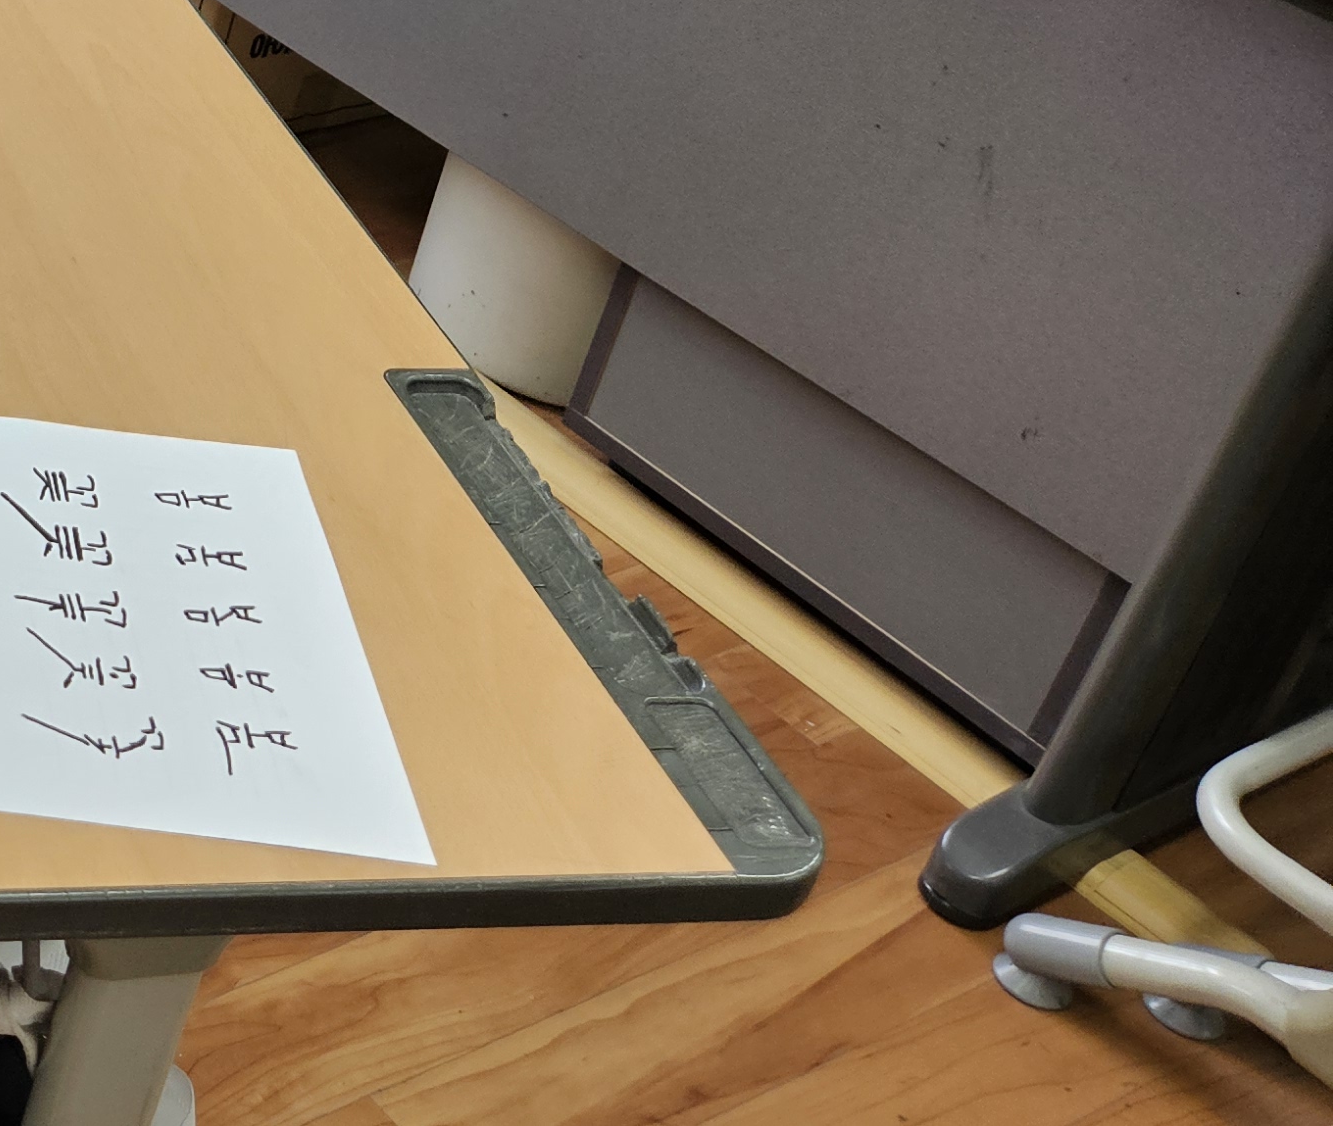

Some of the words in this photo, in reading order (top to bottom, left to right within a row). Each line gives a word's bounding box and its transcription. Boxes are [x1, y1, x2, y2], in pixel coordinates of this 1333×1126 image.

[33, 467, 98, 508] 꽃
[154, 490, 232, 510] 봄
[0, 489, 113, 566] 꽃
[175, 544, 247, 571] 봄
[14, 591, 127, 632] 꽃
[183, 605, 263, 627] 봄
[26, 625, 137, 689] 꽃
[215, 720, 298, 776] 봄
